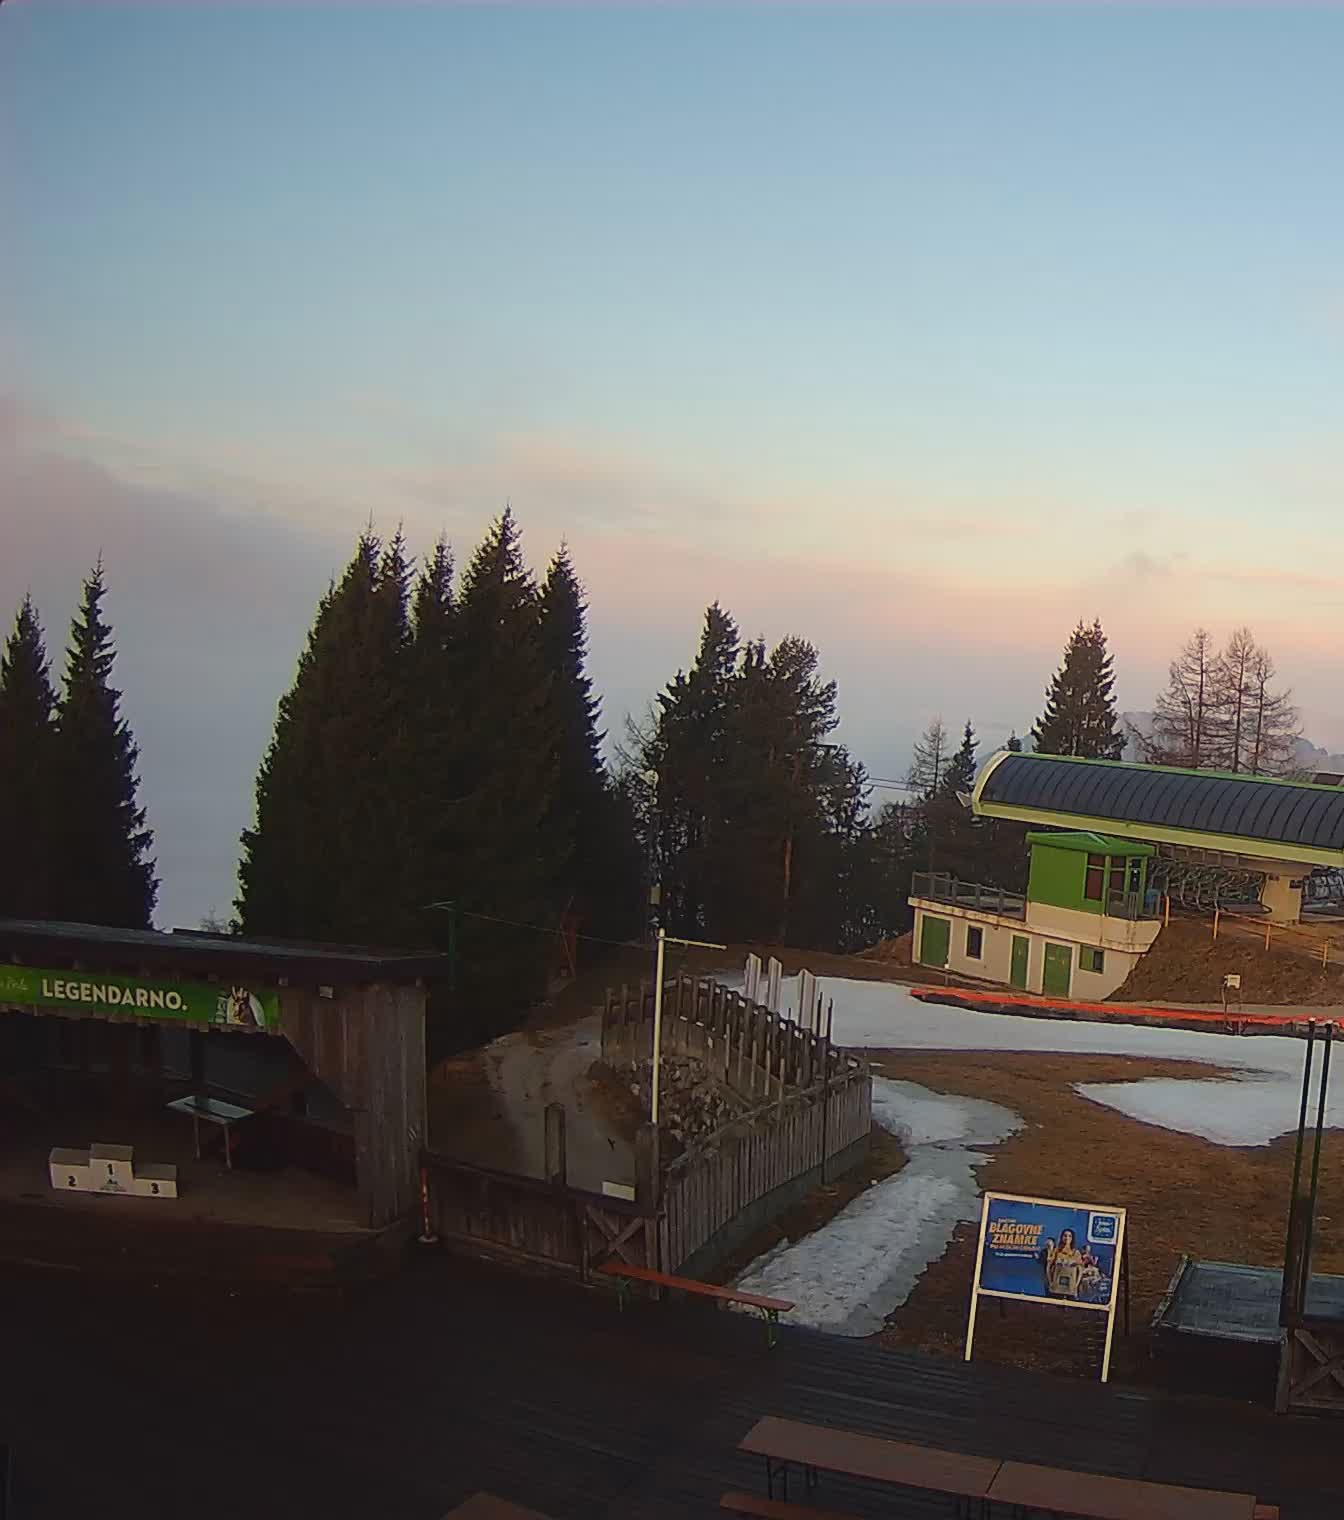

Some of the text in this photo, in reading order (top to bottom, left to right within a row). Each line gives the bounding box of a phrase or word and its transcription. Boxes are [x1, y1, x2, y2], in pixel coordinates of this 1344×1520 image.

[41, 978, 188, 1011] LEGENDARNO.
[107, 1163, 114, 1175] 1
[67, 1175, 76, 1187] 2
[151, 1182, 160, 1194] 3
